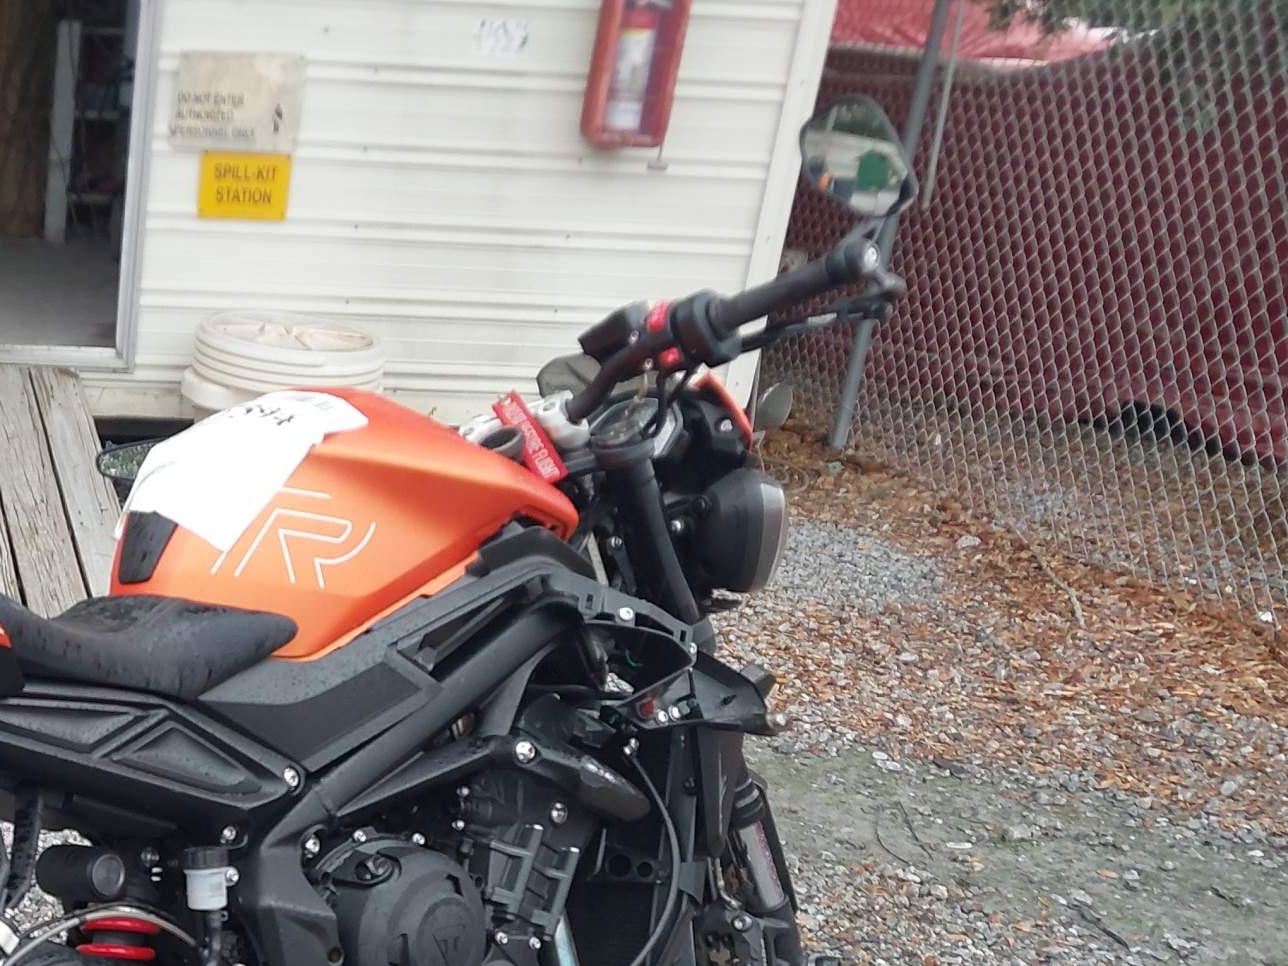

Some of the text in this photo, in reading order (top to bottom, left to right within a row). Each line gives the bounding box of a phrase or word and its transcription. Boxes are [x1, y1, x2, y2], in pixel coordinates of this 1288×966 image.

[193, 91, 211, 104] NOT
[215, 163, 278, 183] SPILL-KIT
[215, 186, 273, 206] STATION
[532, 448, 562, 480] FLIGHT
